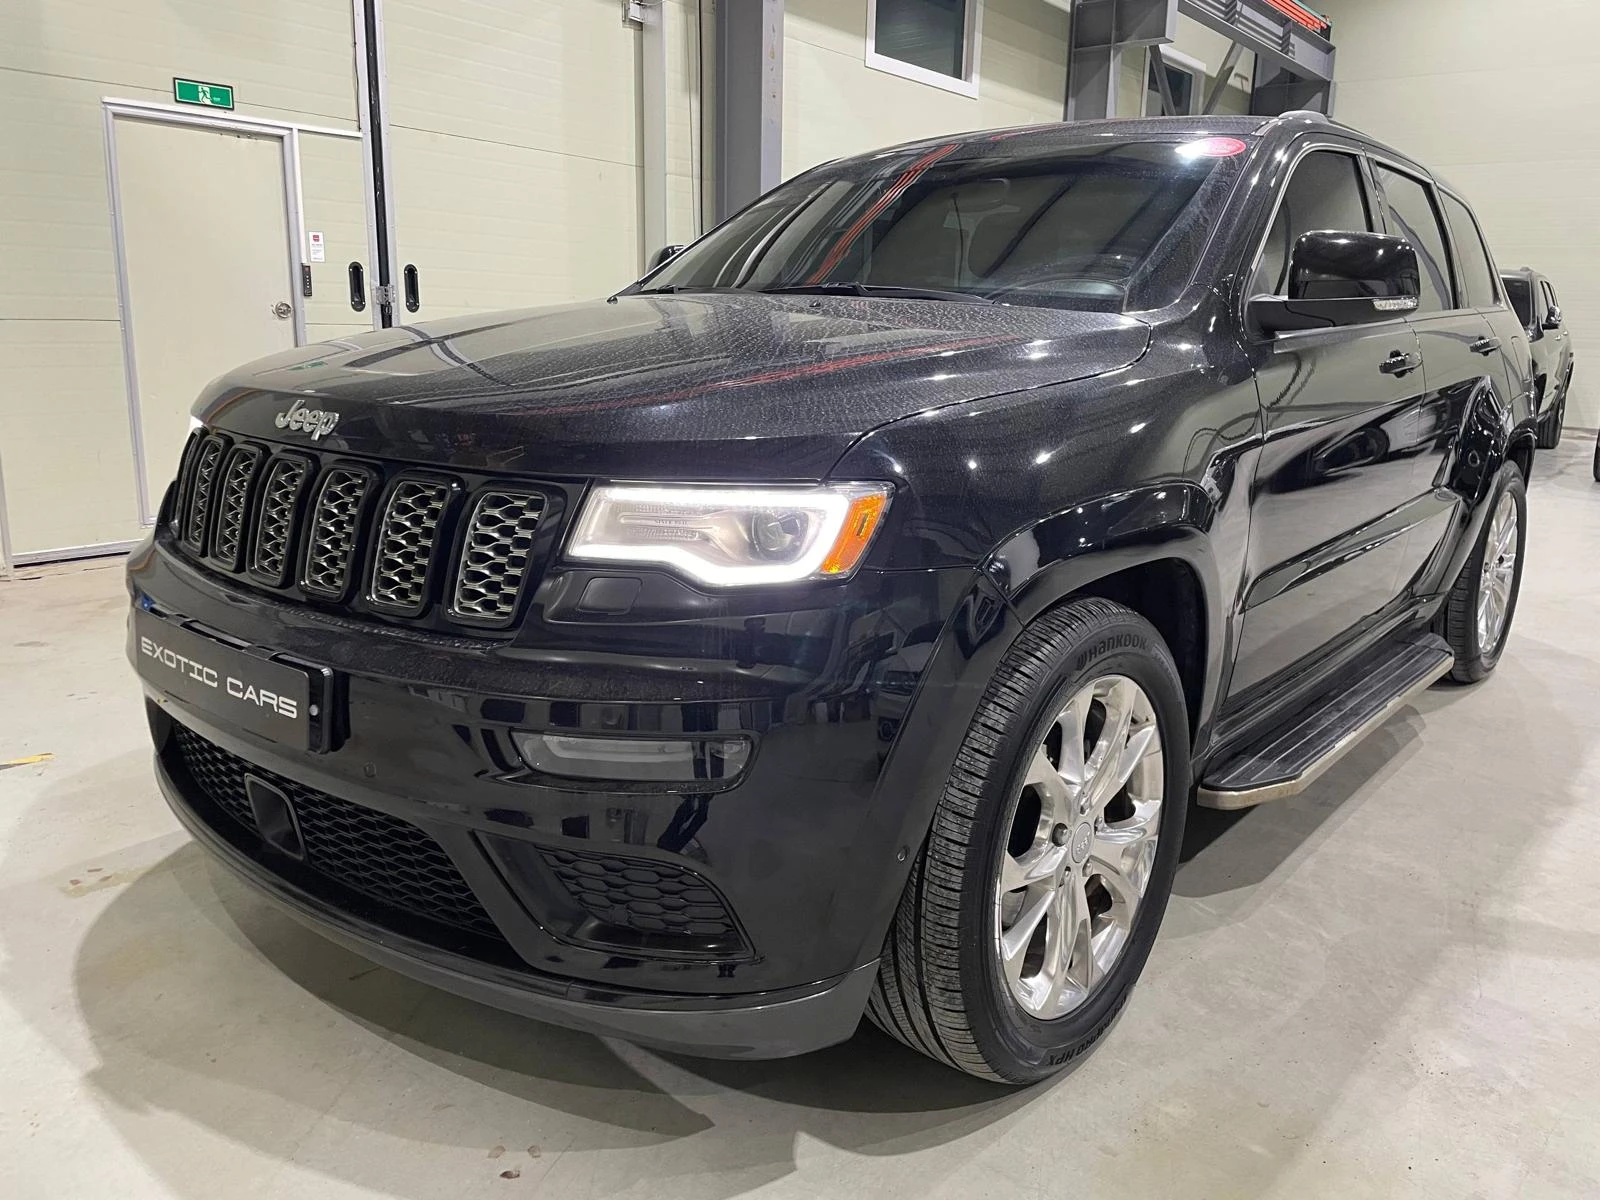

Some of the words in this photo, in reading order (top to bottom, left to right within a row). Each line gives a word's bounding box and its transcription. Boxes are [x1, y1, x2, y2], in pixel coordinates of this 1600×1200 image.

[275, 399, 340, 441] Jeep
[141, 636, 218, 688] EXOTIC
[226, 676, 298, 719] CARS
